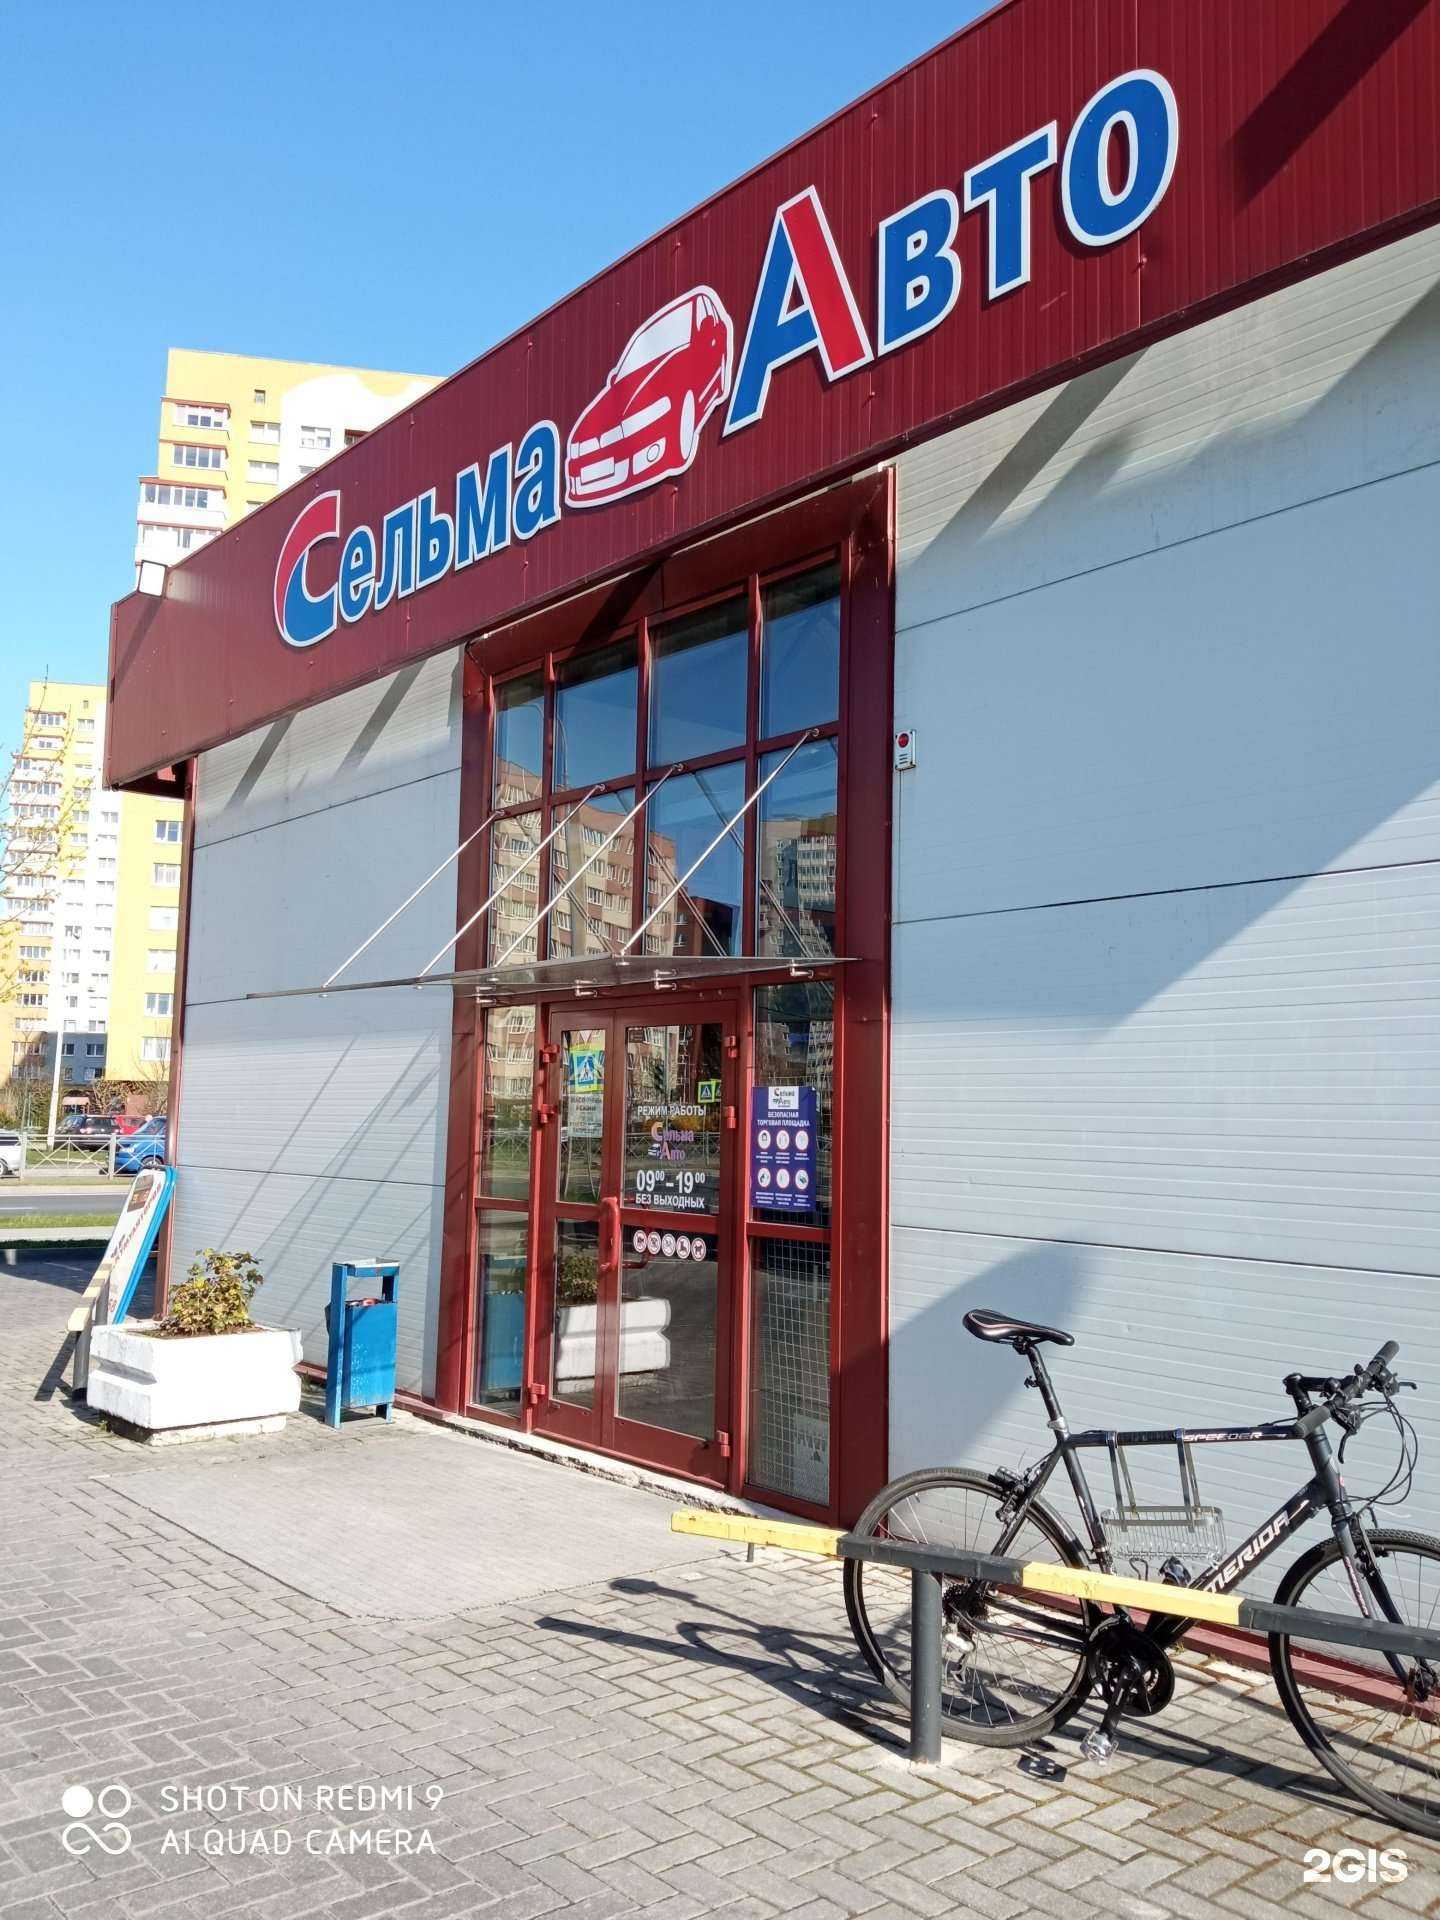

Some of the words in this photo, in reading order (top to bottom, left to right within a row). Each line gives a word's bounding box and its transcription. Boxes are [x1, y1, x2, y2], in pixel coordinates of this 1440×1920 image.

[275, 420, 562, 648] Сельма
[723, 68, 1179, 437] Авто
[637, 1105, 668, 1116] РЕЖИМ
[669, 1105, 707, 1116] РАБОТЫ
[635, 1193, 652, 1205] БЕЗ
[653, 1194, 705, 1208] ВЫХОДНЫХ
